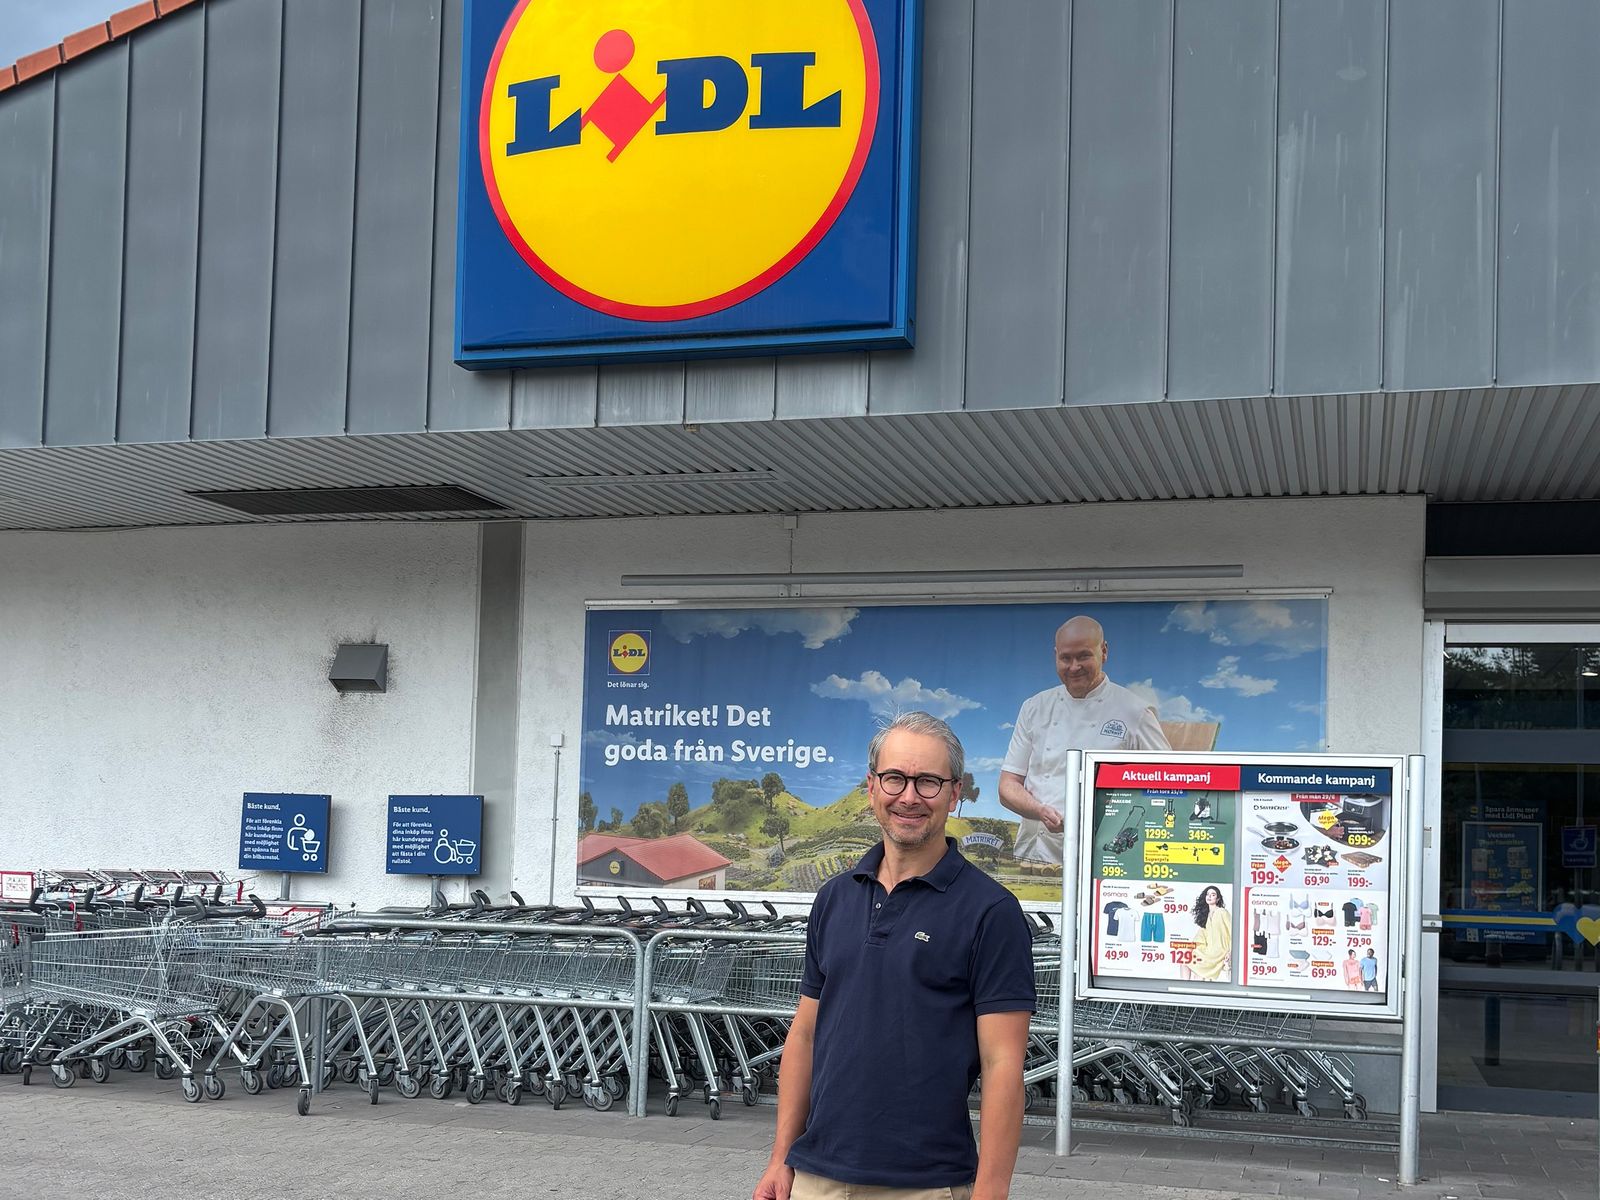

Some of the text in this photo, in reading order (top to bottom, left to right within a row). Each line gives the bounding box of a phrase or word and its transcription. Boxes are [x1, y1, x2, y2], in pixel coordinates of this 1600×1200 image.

[619, 680, 637, 688] lönar
[638, 681, 650, 690] sig.
[605, 702, 771, 727] Matriket! Det
[604, 738, 834, 769] goda från Sverige.
[1122, 771, 1211, 785] Aktuell kampanj
[1258, 772, 1375, 788] Kommande kampanj
[264, 803, 281, 811] kund,
[1145, 828, 1174, 840] 1299:-
[1188, 829, 1214, 841] 349:-
[1347, 834, 1376, 846] 699:-
[1102, 865, 1127, 877] 999:-
[1143, 864, 1179, 879] 999:-
[1250, 870, 1284, 885] 199:-
[1348, 877, 1373, 888] 199:-
[1311, 935, 1337, 947] 129:-
[1170, 950, 1202, 965] 129:-
